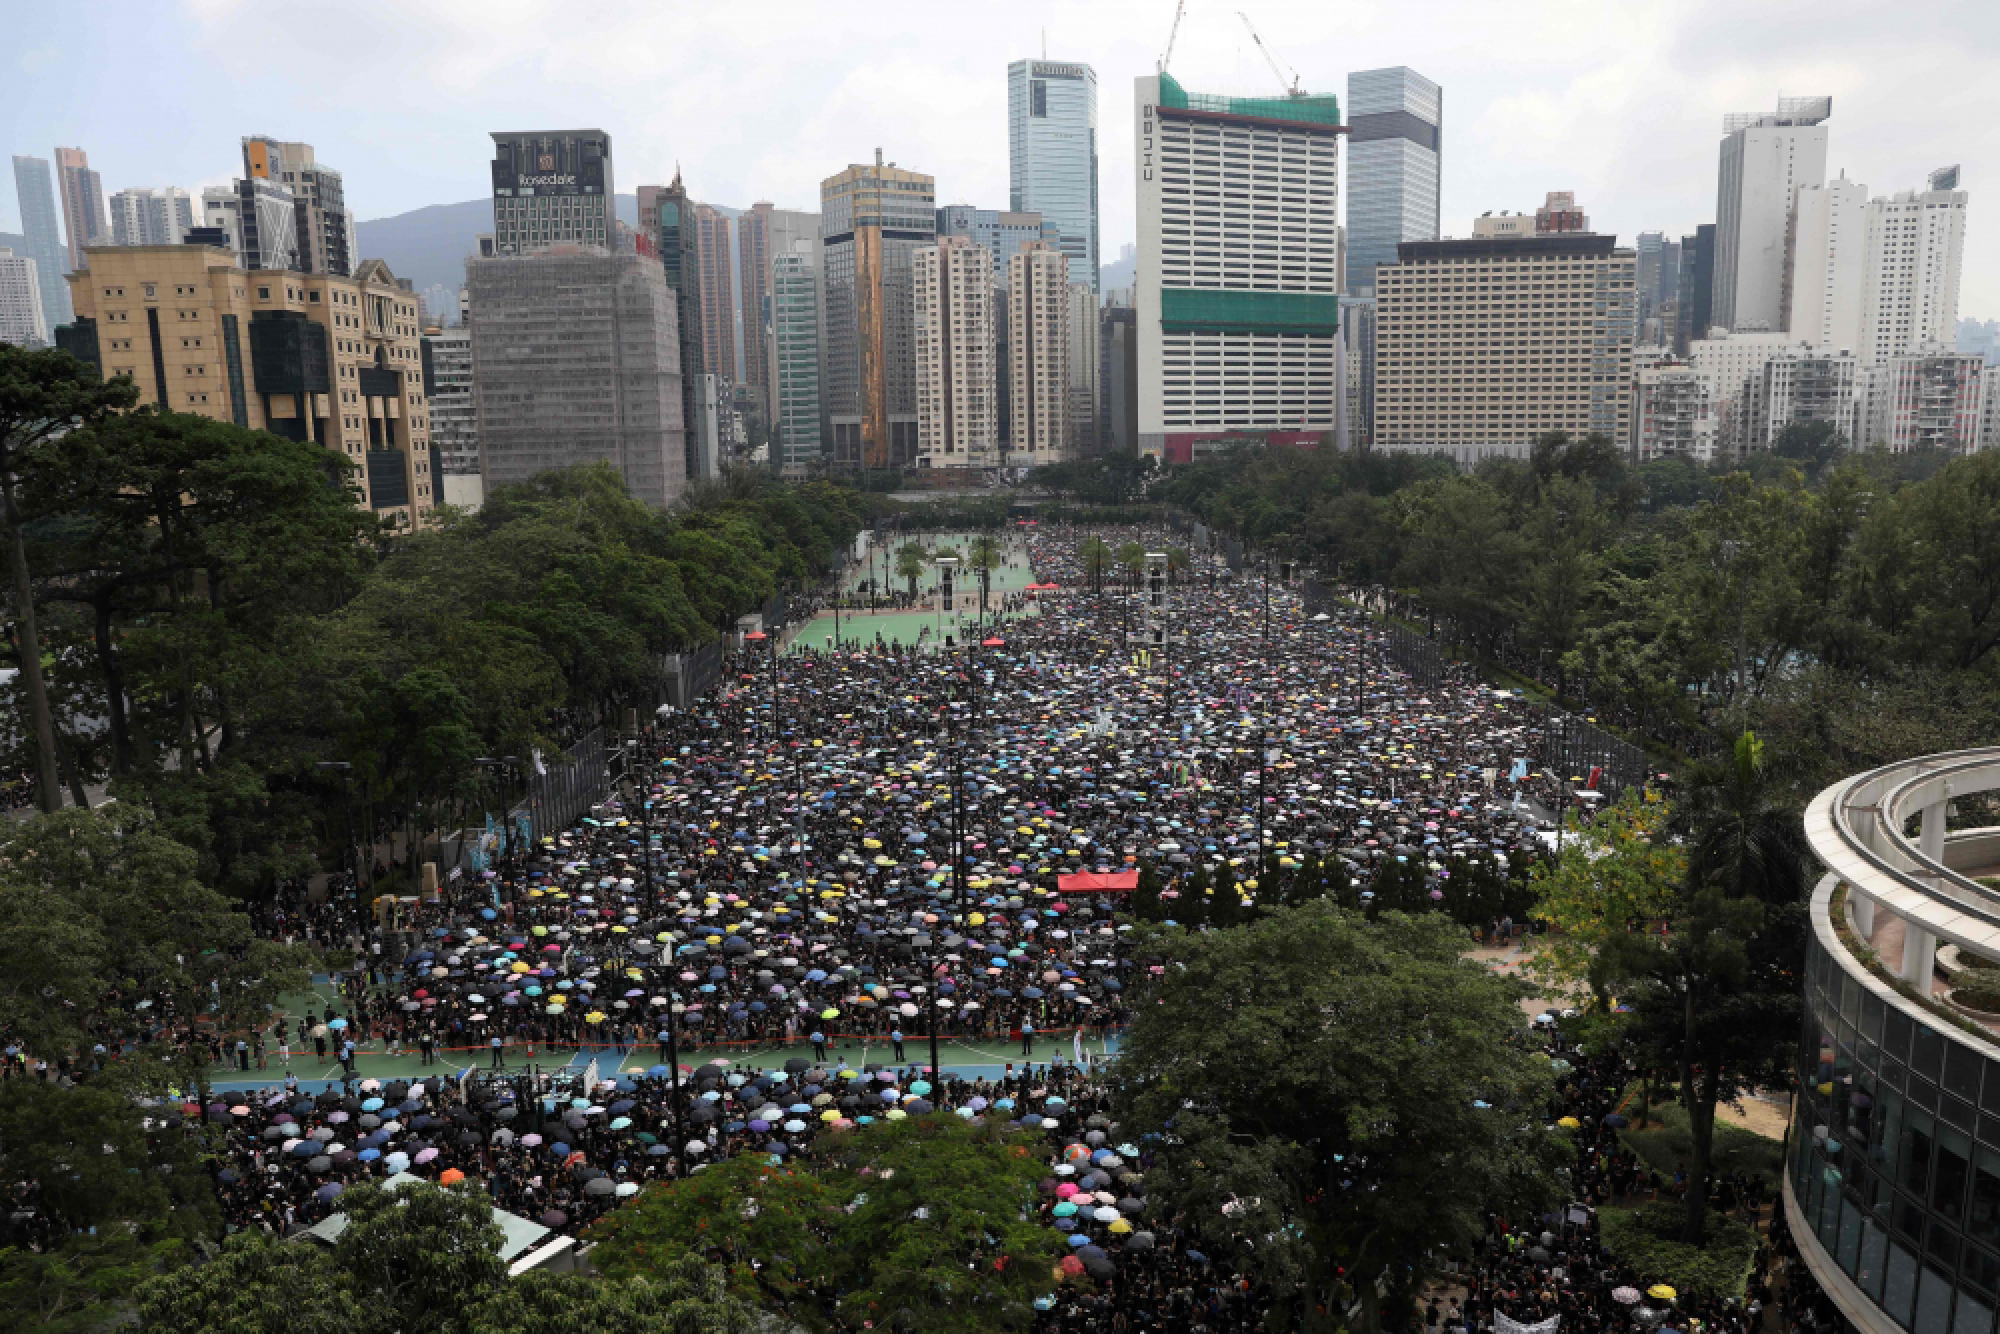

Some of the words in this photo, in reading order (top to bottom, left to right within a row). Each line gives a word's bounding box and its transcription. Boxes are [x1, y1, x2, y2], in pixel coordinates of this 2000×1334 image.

[1144, 104, 1152, 180] CHUBB
[518, 172, 577, 186] Rosedale
[1938, 212, 1946, 244] THE
[1928, 252, 1942, 338] EXCELSIO
